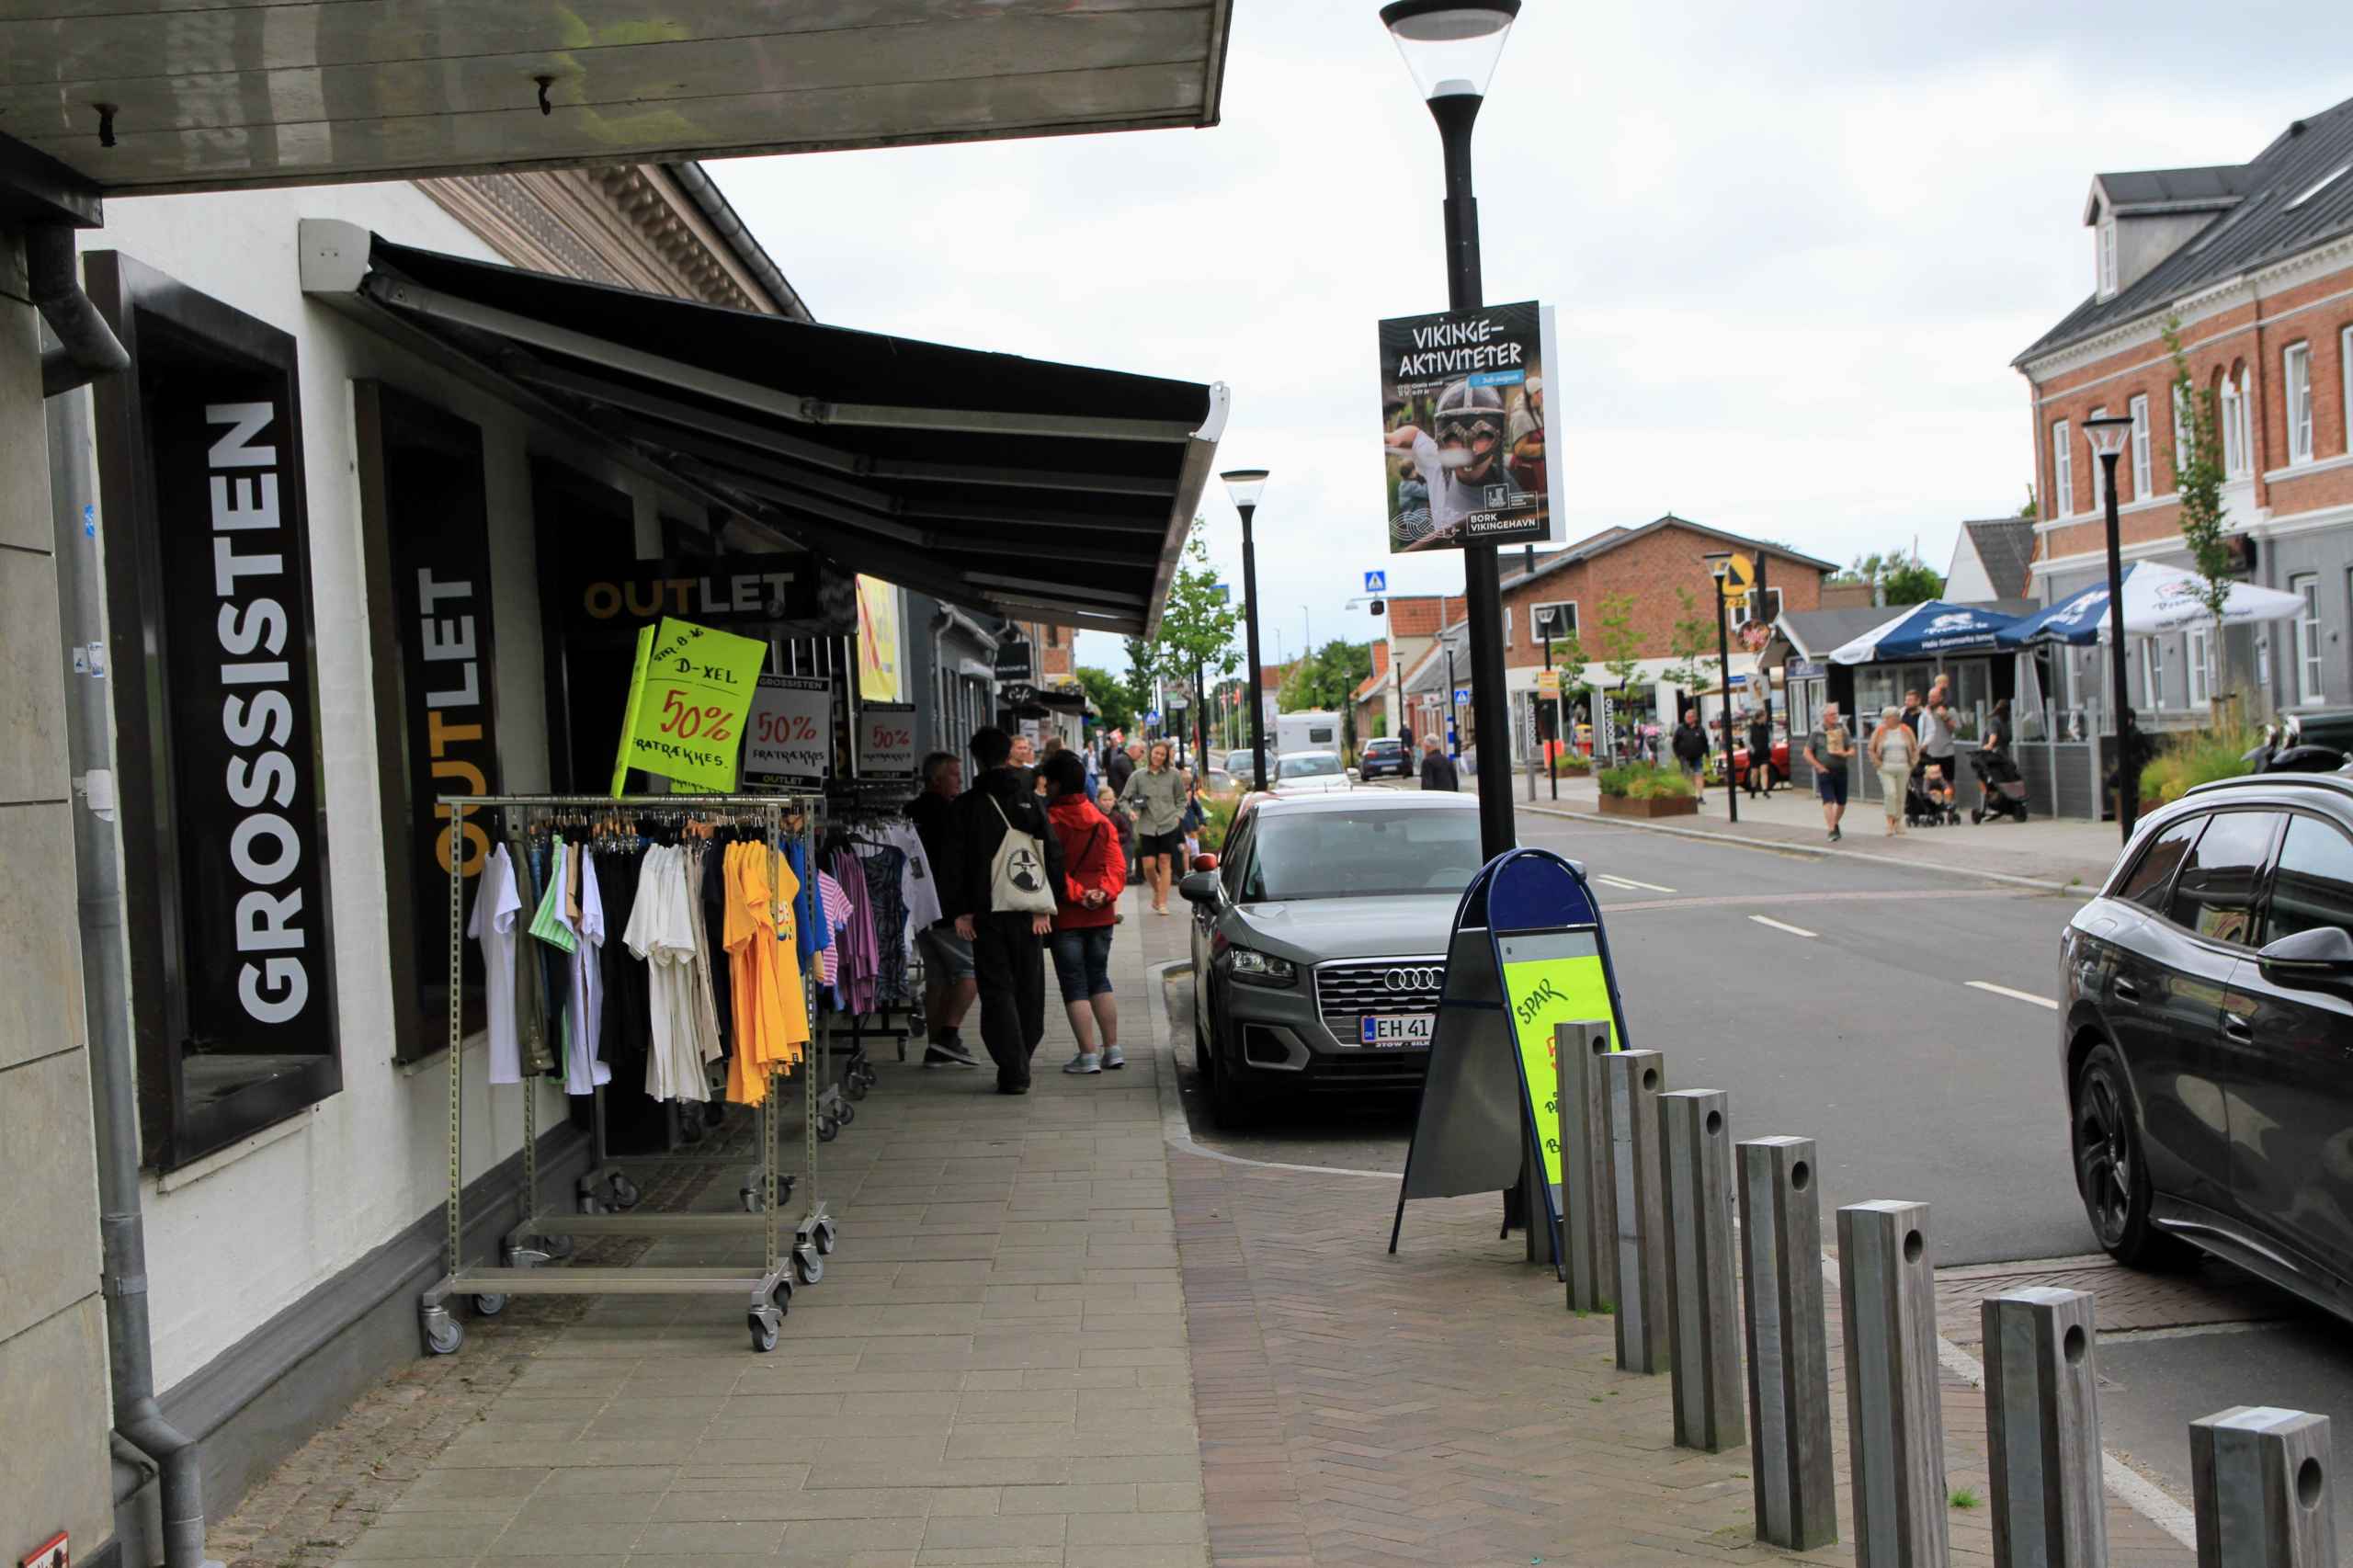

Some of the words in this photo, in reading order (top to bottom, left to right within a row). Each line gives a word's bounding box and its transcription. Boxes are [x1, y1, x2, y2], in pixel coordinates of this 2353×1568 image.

[1413, 320, 1504, 349] VIKINGE-
[1399, 342, 1522, 377] AKTIVITETER
[1471, 513, 1498, 524] BORK
[1471, 518, 1536, 532] VIKINGEHAVN
[584, 572, 794, 619] OUTLET
[674, 658, 738, 684] D-XEL
[759, 676, 824, 690] GROSSISTEN
[205, 402, 309, 1024] GROSSISTEN
[418, 567, 491, 878] OUTLET
[660, 689, 734, 741] 50%
[756, 711, 818, 744] 50%
[872, 725, 911, 749] 50%
[762, 775, 804, 786] OUTLET
[1517, 978, 1568, 1025] SPAR
[1378, 1020, 1402, 1037] EH
